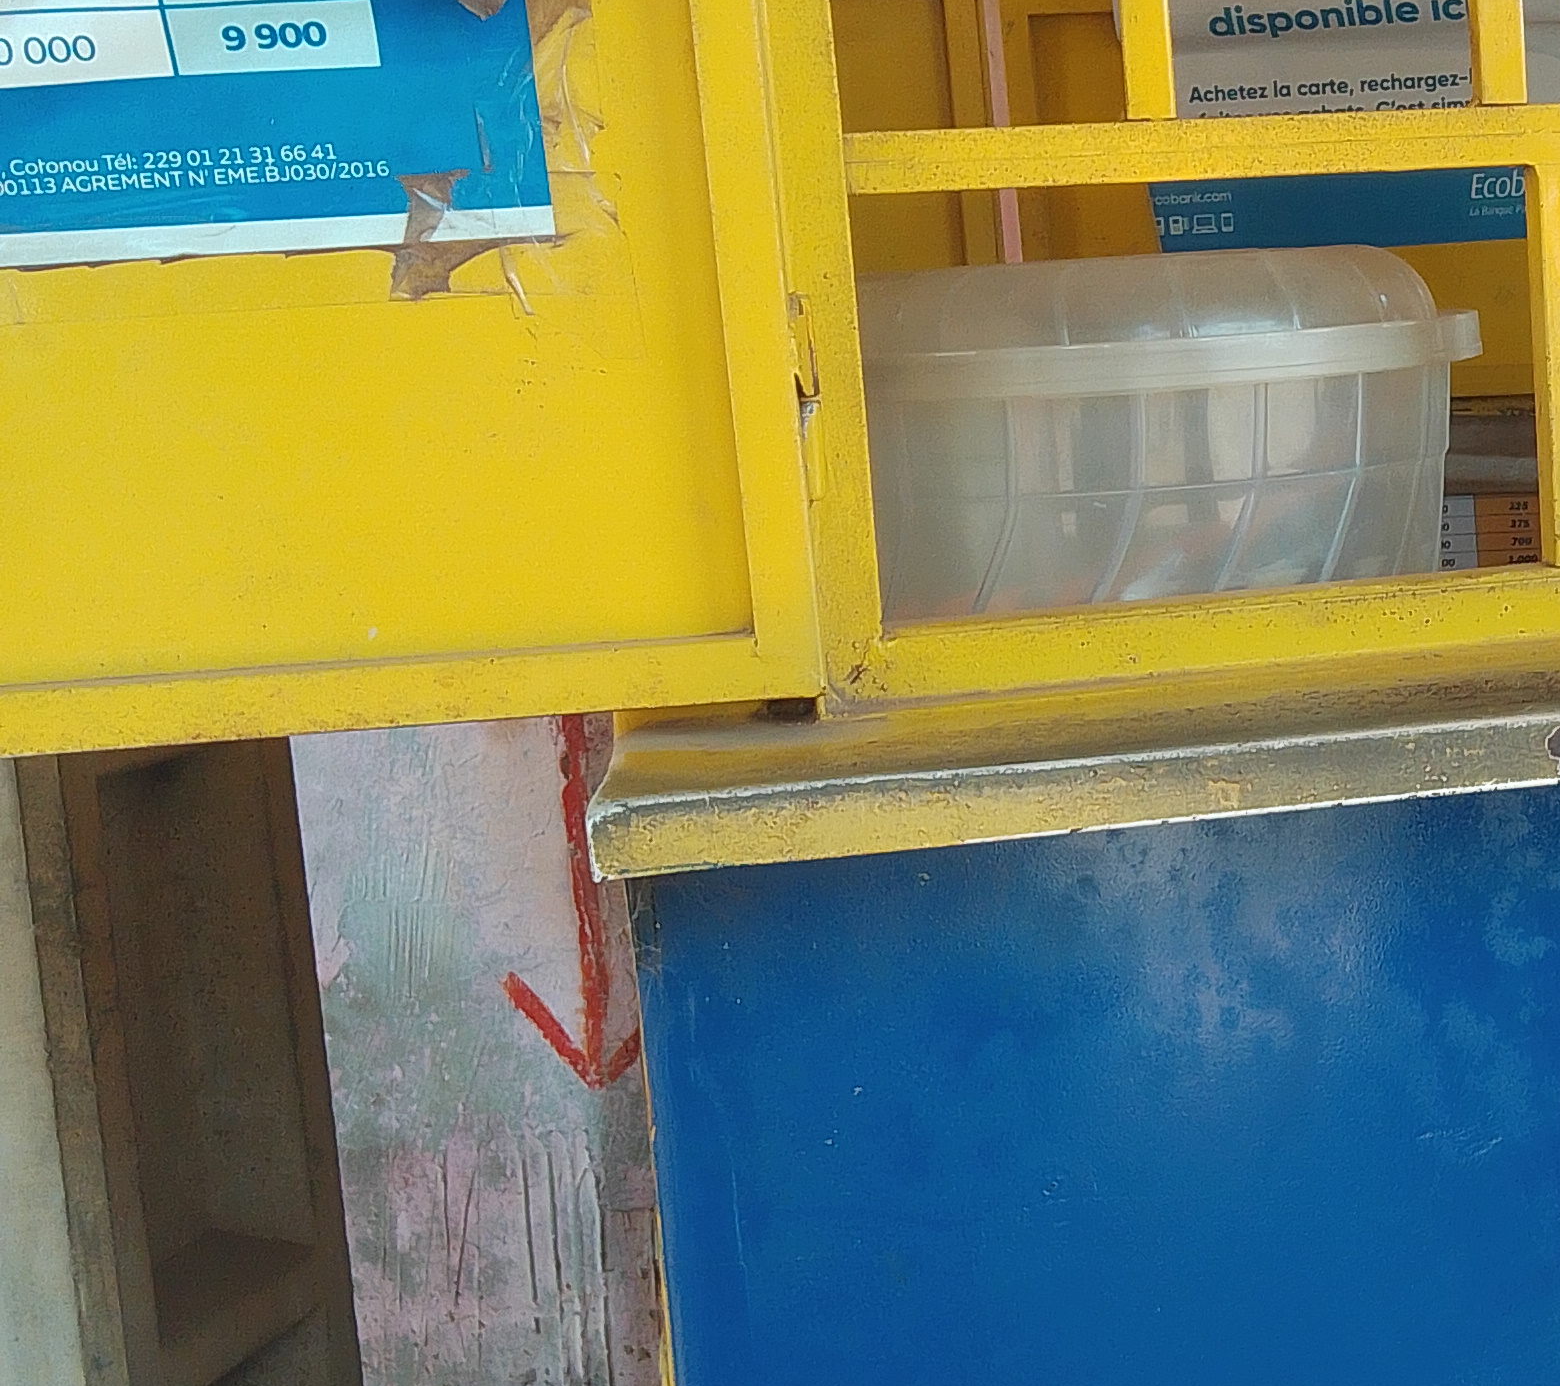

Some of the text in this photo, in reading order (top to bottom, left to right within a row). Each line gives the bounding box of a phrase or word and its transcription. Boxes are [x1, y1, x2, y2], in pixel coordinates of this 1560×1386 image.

[1188, 84, 1268, 105] Achetez
[1273, 79, 1292, 99] la
[1297, 78, 1355, 98] carte,
[9, 158, 99, 176] Cotonou
[102, 153, 138, 173] Tél:
[144, 151, 181, 169] 229
[186, 148, 213, 166] 01
[218, 147, 244, 165] 21
[250, 146, 274, 164] 31
[280, 144, 306, 162] 66
[310, 143, 337, 160] 41
[60, 171, 183, 194] AGREMENT
[214, 161, 390, 185] EME.BJ030/2016
